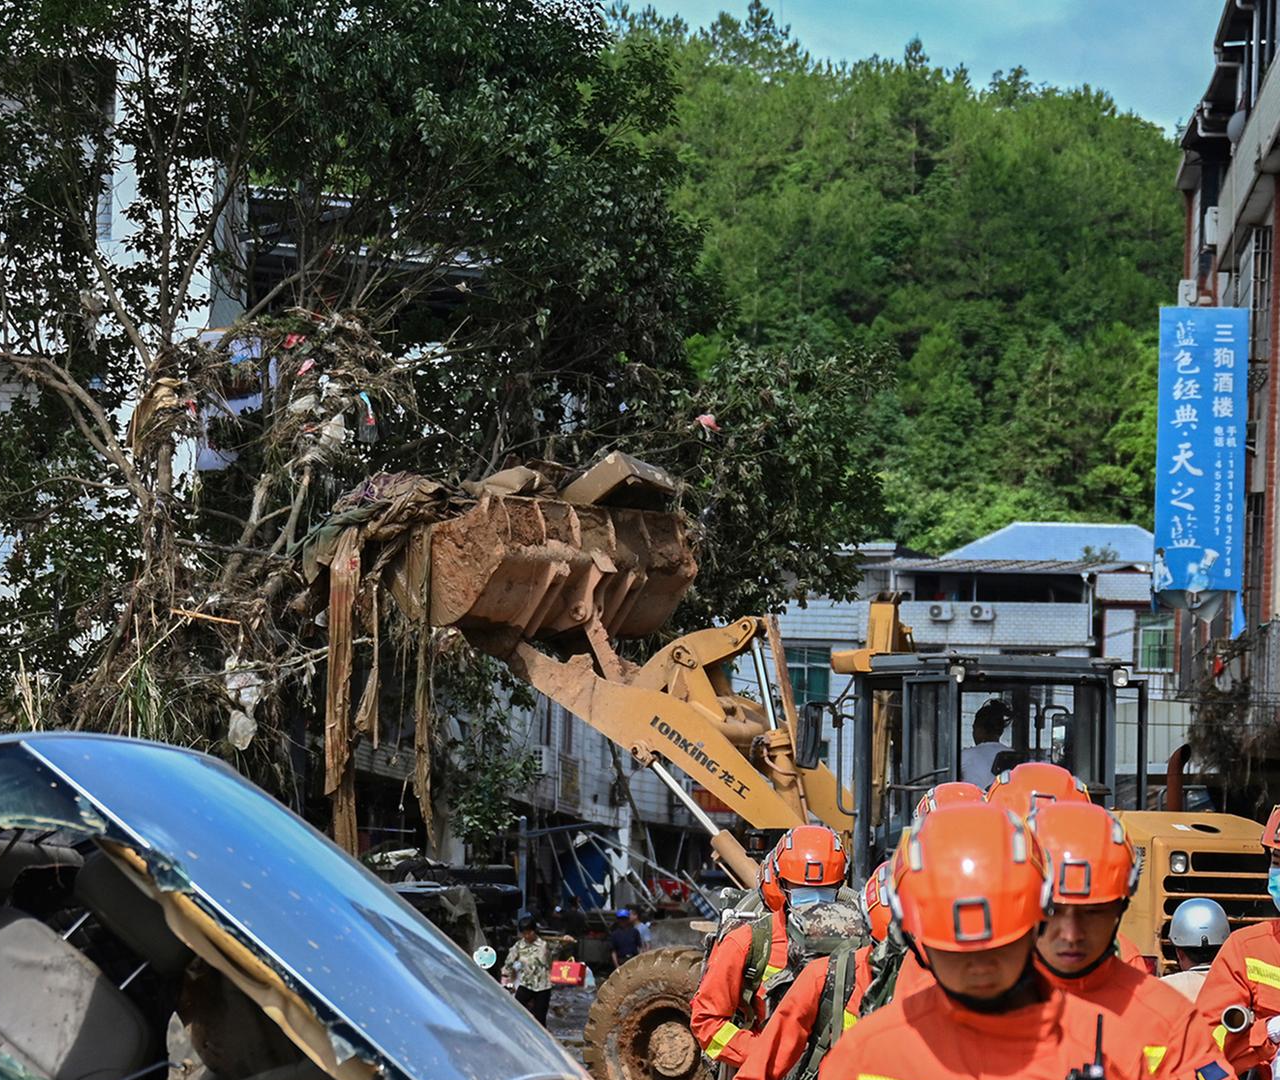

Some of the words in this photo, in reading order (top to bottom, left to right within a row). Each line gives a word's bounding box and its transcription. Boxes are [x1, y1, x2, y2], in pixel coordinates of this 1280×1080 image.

[1212, 323, 1235, 418] 三狗酒楼
[718, 769, 751, 800] 龙工
